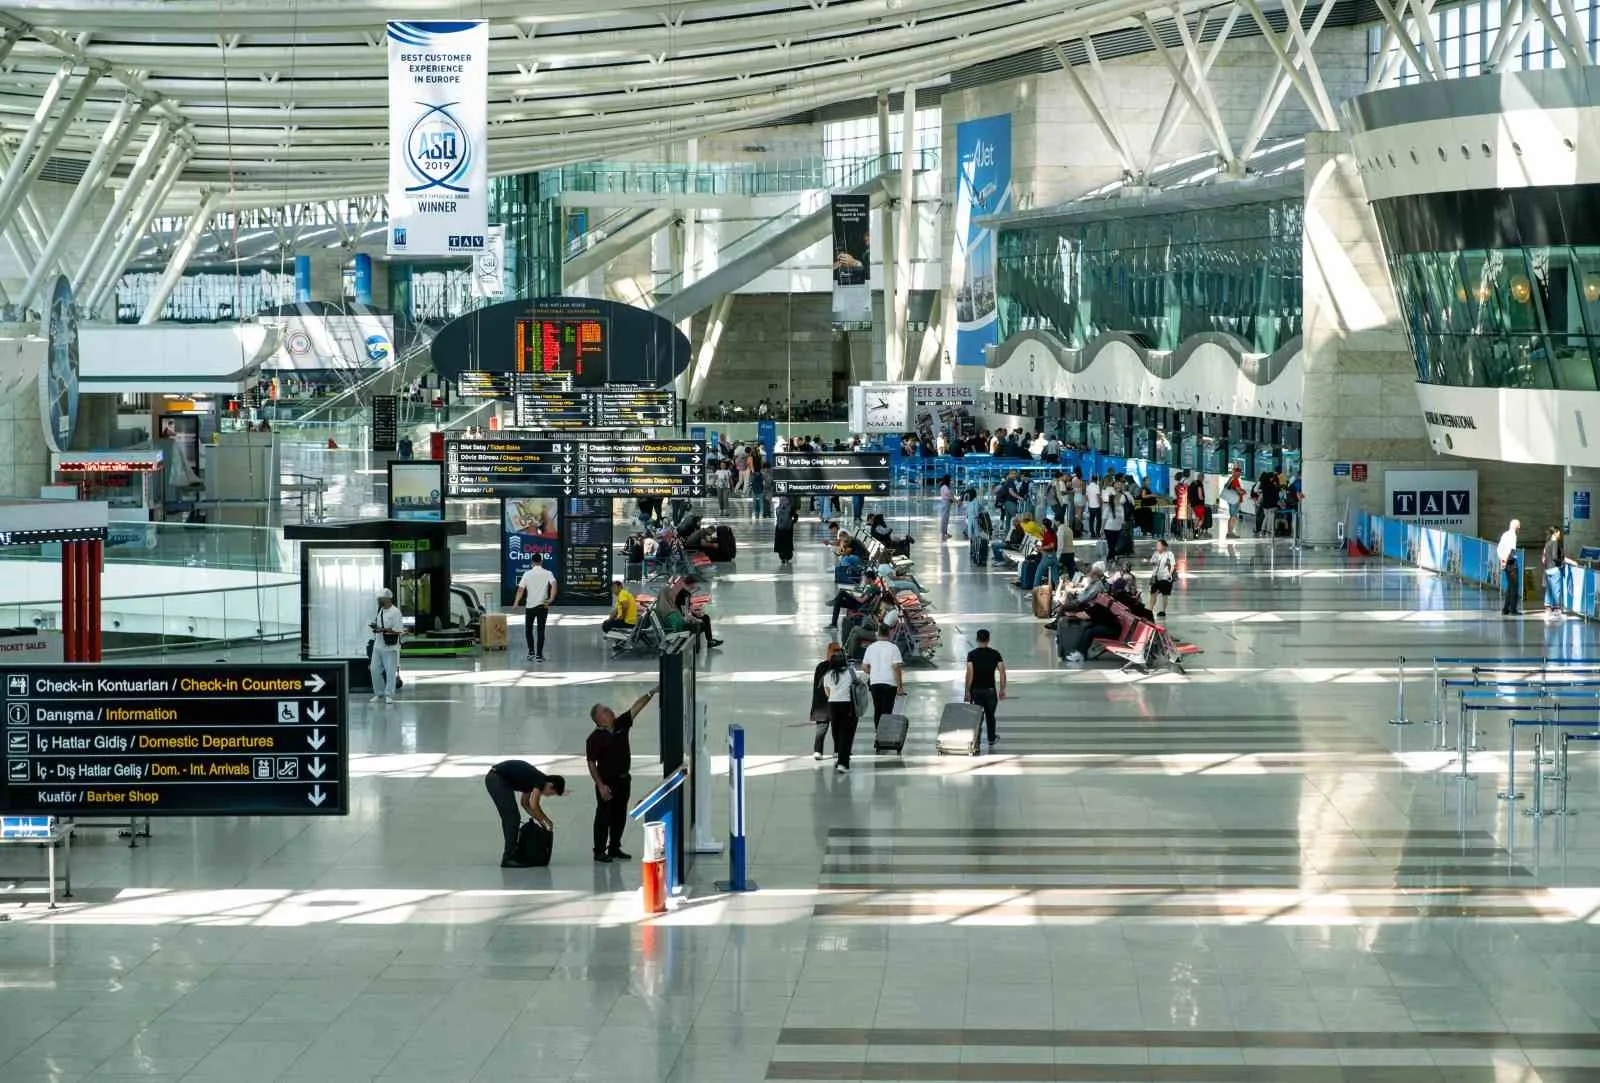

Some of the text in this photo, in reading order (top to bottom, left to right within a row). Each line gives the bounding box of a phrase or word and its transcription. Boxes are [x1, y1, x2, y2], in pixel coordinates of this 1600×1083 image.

[401, 54, 472, 62] BEST CUSTOMER
[409, 65, 463, 73] EXPERIENCE
[418, 133, 457, 160] ASQ
[425, 161, 450, 170] 2019
[418, 202, 457, 213] WINNER
[449, 236, 483, 247] TAV
[915, 388, 972, 397] ETE & TEKEL
[1397, 494, 1466, 512] TAV
[25, 642, 48, 650] SALES
[36, 678, 302, 691] Check-in Kontuarları / Check-in Counters
[36, 708, 177, 724] Danışma / Information
[37, 734, 274, 752] İç Hatlar Gidiş / Domestic Departures
[37, 762, 47, 780] İç
[57, 764, 76, 780] Dış
[79, 764, 112, 777] Hatlar
[115, 764, 142, 779] Geliş
[144, 764, 149, 777] /
[152, 764, 180, 777] Dom.
[190, 764, 207, 777] Int.
[210, 764, 250, 777] Arrivals
[38, 790, 159, 805] Kuaför / Barber Shop
